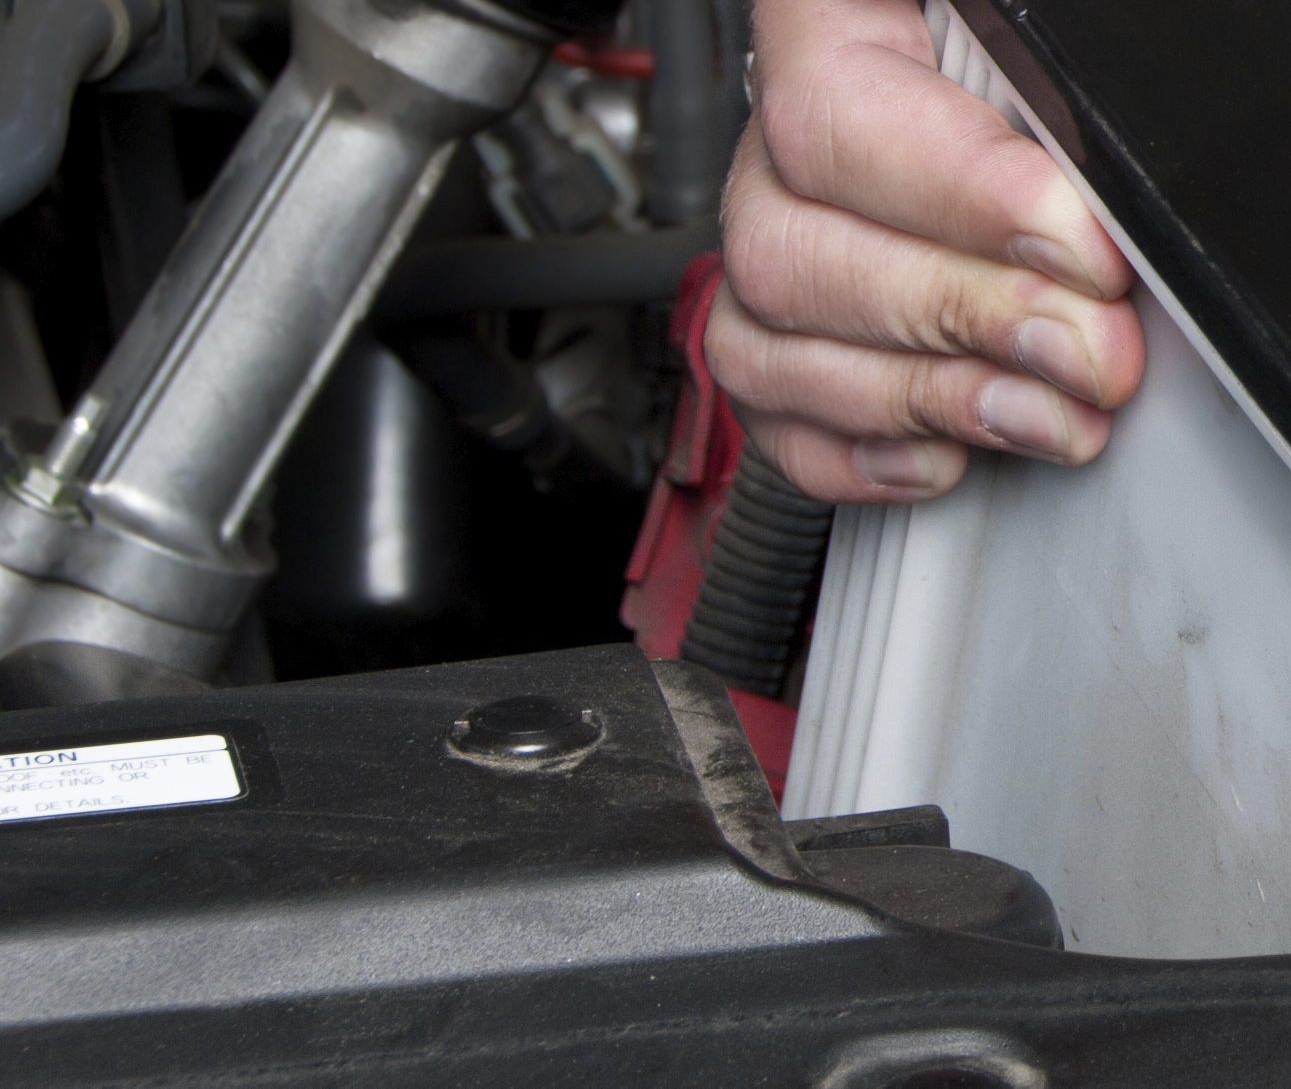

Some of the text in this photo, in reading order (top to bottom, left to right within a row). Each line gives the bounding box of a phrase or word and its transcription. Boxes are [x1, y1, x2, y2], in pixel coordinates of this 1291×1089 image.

[0, 751, 77, 768] TION
[110, 758, 170, 772] MUST
[186, 754, 213, 765] BE
[118, 772, 149, 782] OR
